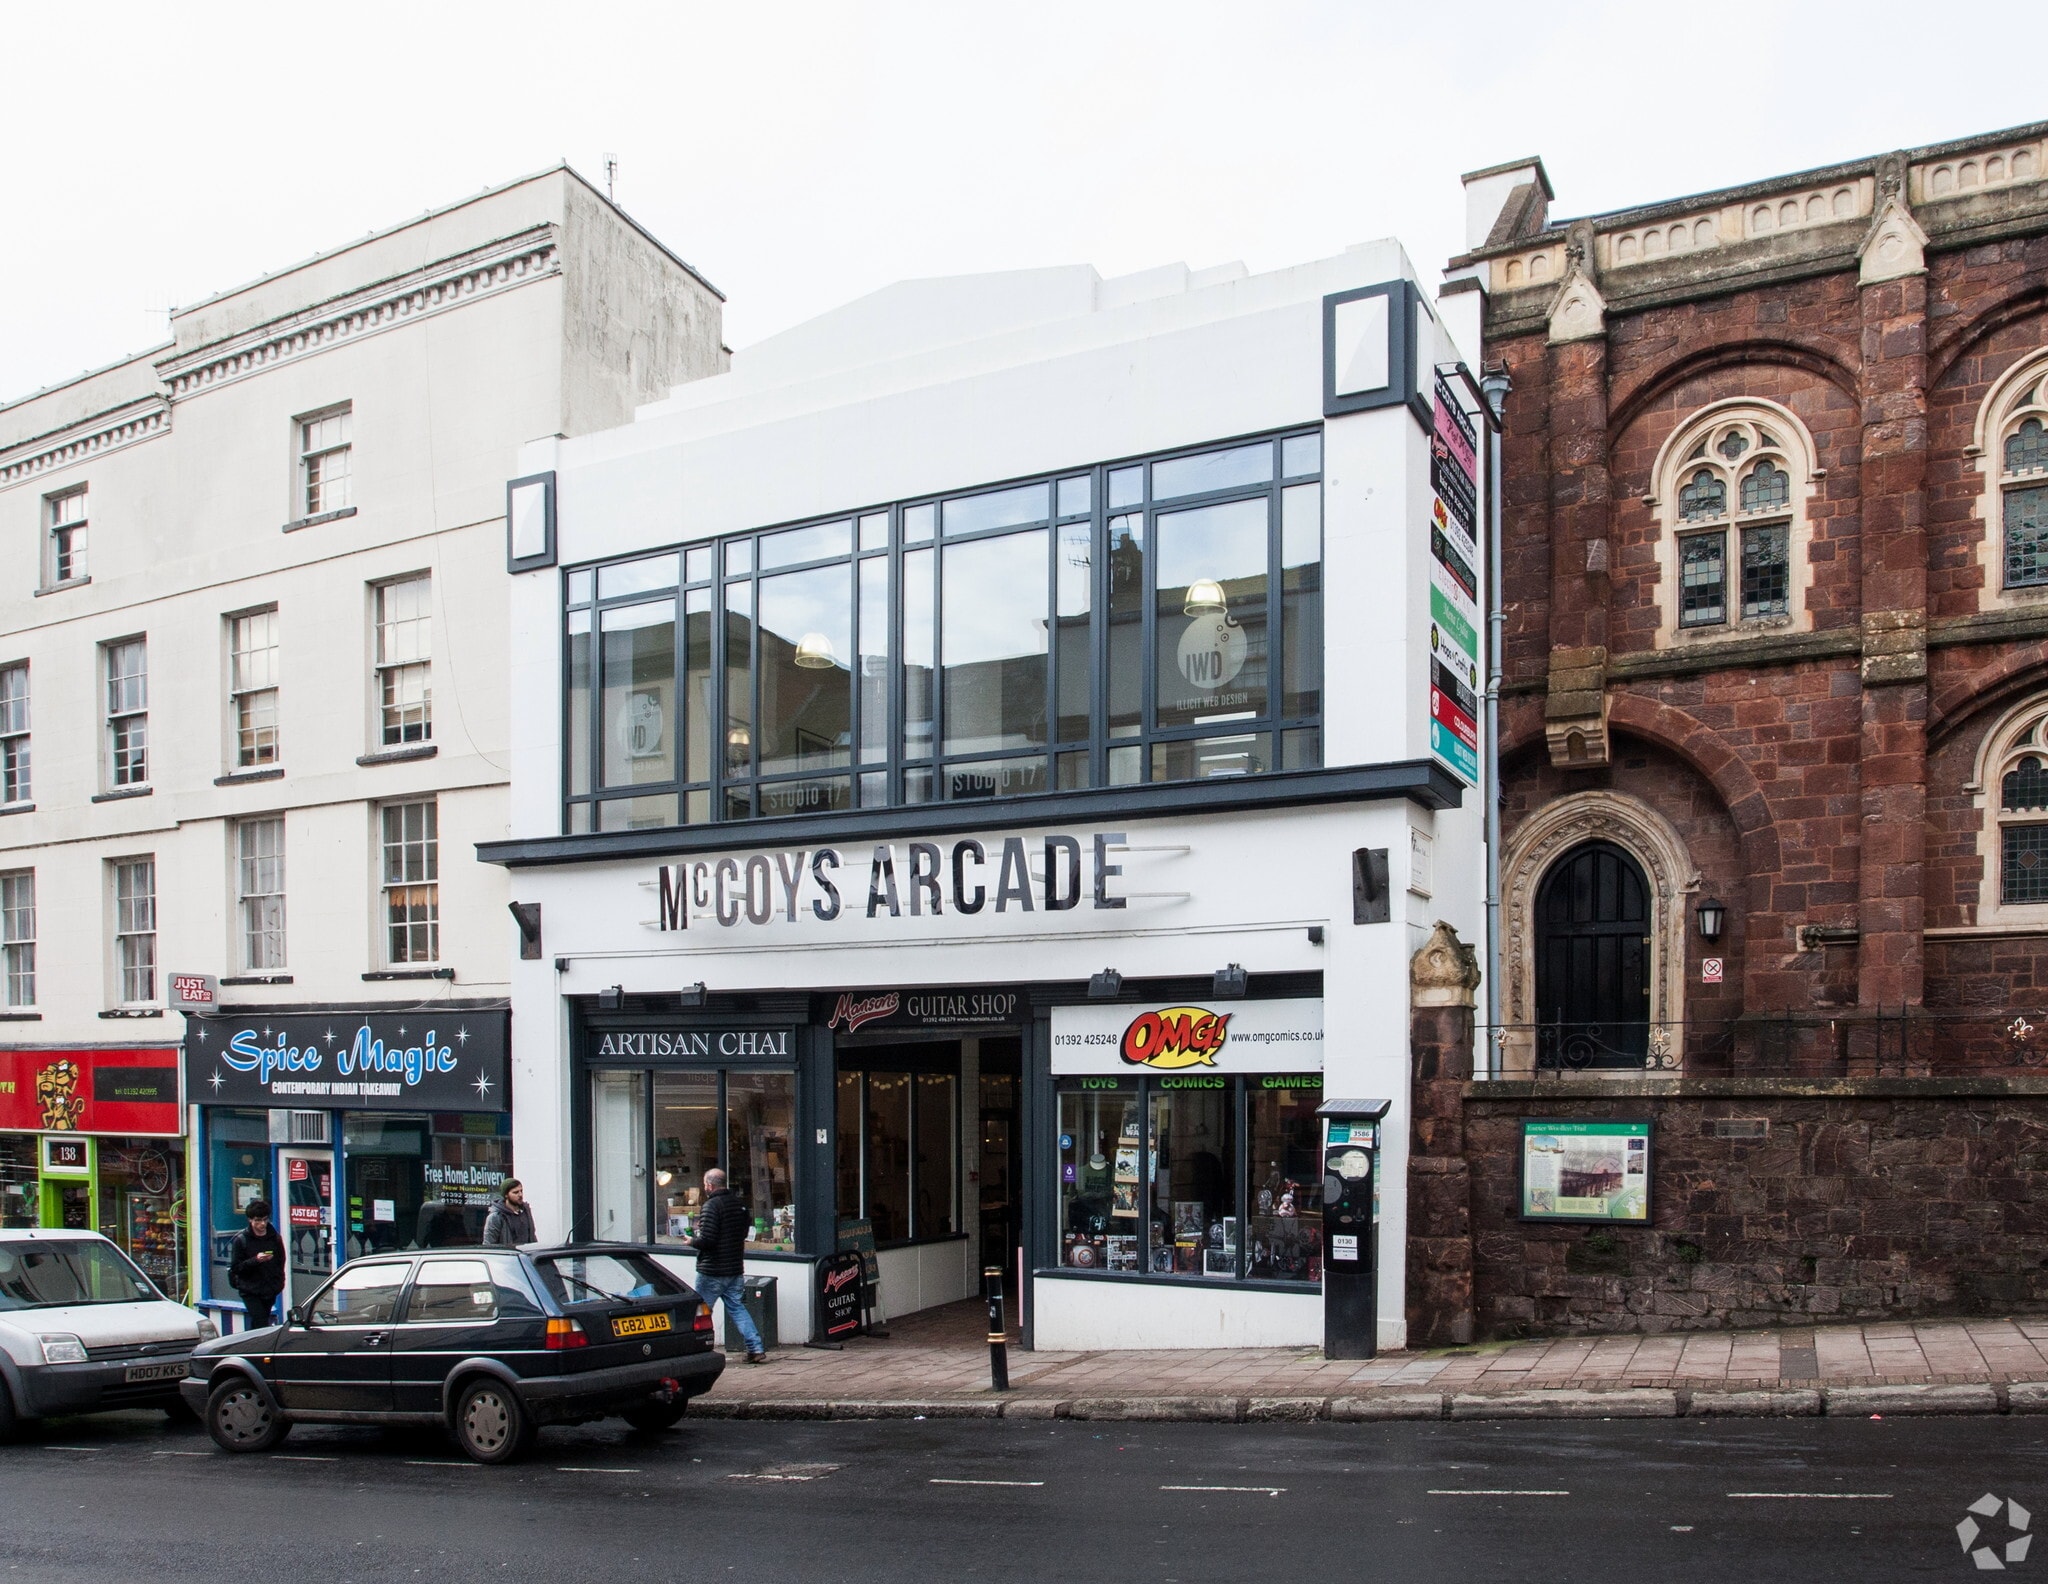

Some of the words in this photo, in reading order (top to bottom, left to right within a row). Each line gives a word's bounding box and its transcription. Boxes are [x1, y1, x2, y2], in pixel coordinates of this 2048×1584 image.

[1186, 651, 1222, 682] IWD
[1204, 695, 1219, 707] WEB
[1221, 692, 1248, 706] DESIGN
[955, 773, 1010, 792] STUDIO
[1020, 766, 1037, 786] 17
[770, 787, 819, 809] STUDIO
[827, 785, 842, 804] 17
[866, 833, 1127, 918] ARCADE
[174, 976, 204, 990] JUST
[182, 989, 204, 1000] EAT
[828, 992, 899, 1032] Mansons
[908, 996, 969, 1017] GUITAR
[971, 994, 1016, 1015] SHOP
[598, 1033, 710, 1056] ARTISAN
[718, 1032, 787, 1056] CHAI
[1055, 1035, 1082, 1046] 01392
[1084, 1034, 1117, 1046] 425248
[1120, 1012, 1234, 1065] OMG!
[1231, 1028, 1324, 1045] www.omgcomics.co.uk
[221, 1029, 322, 1084] Spice
[337, 1025, 457, 1086] Magic
[0, 1081, 15, 1094] TH
[271, 1082, 331, 1095] CONTEMPORARY
[331, 1082, 358, 1095] INDIAN
[359, 1082, 401, 1096] TAKEAWAY
[1081, 1077, 1118, 1089] TOYS
[1160, 1077, 1225, 1089] COMICS
[1262, 1076, 1323, 1089] GAMES
[61, 1146, 76, 1161] 138
[424, 1164, 443, 1182] Free
[445, 1165, 469, 1184] Home
[470, 1166, 506, 1186] Delivery
[291, 1208, 305, 1217] JUST
[306, 1209, 318, 1217] EAT
[828, 1293, 855, 1308] GUITAR
[835, 1306, 852, 1318] SHOP
[649, 1315, 667, 1329] JAB
[130, 1367, 160, 1380] HD07
[163, 1364, 184, 1376] KKS
